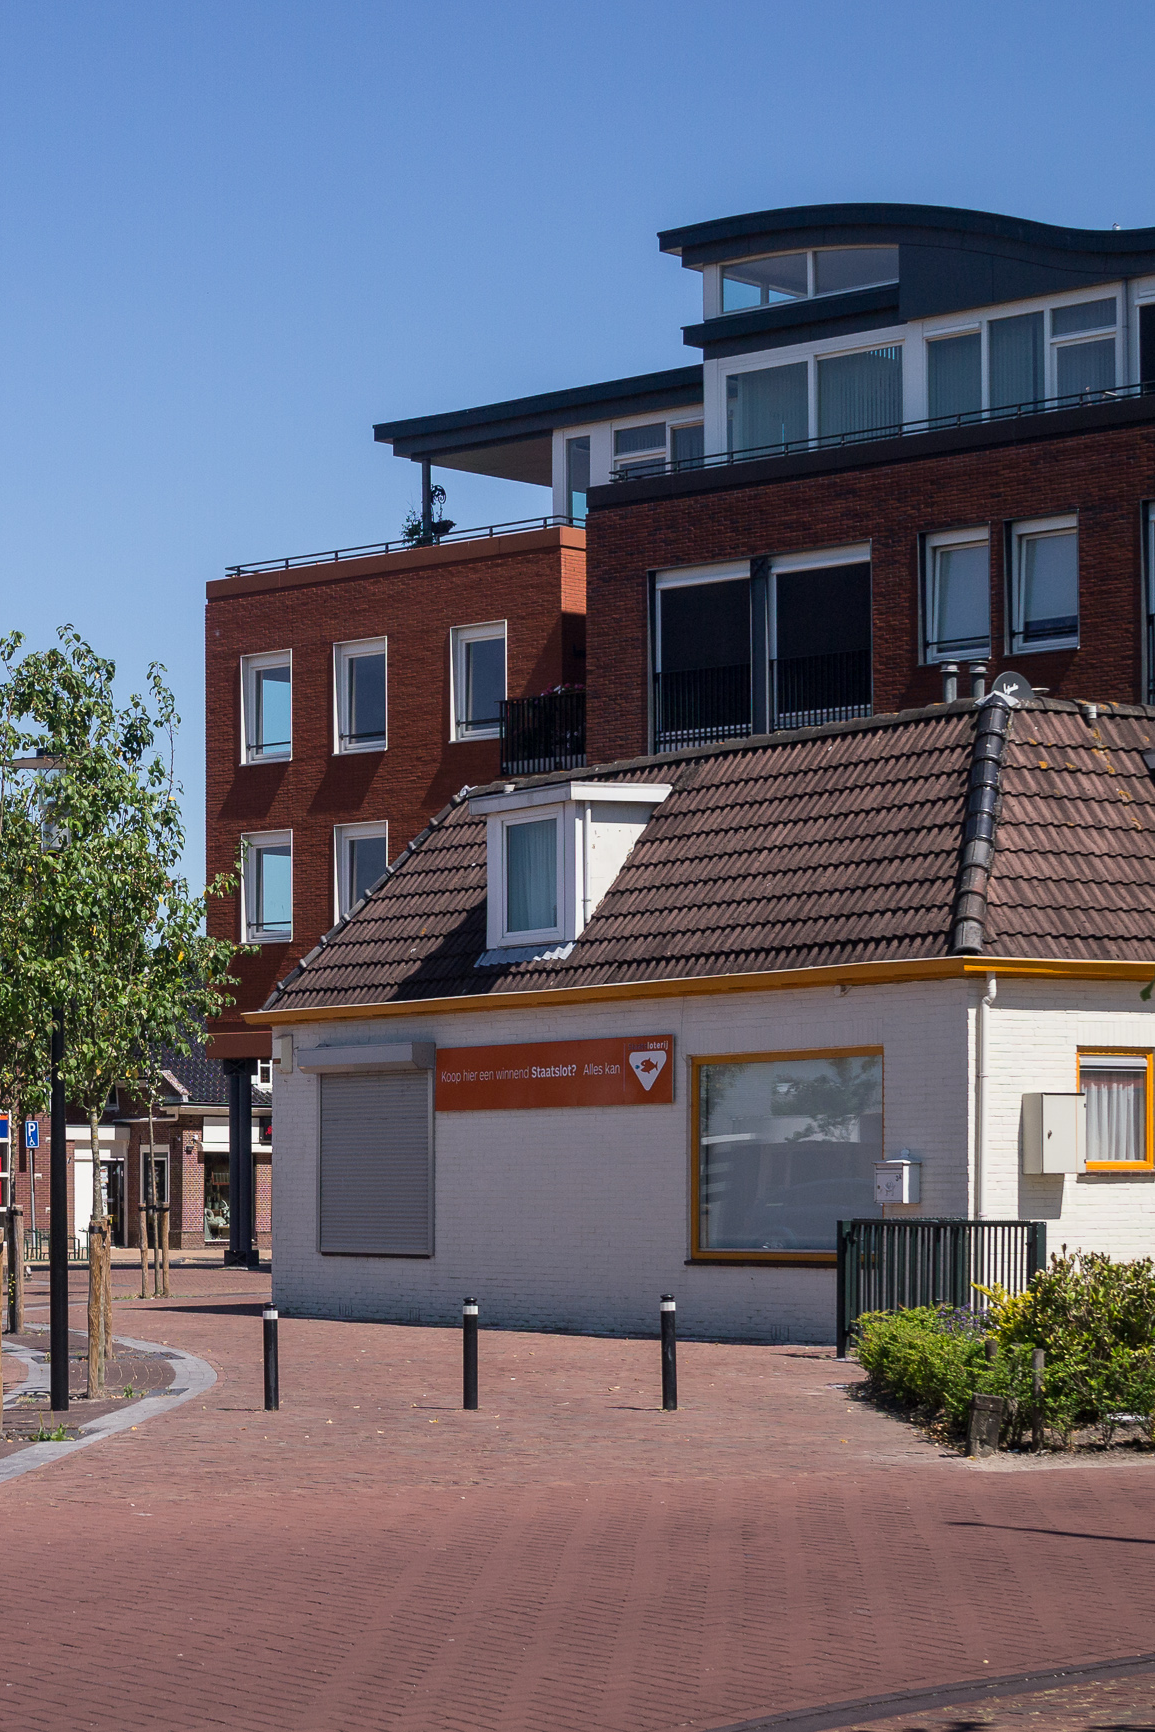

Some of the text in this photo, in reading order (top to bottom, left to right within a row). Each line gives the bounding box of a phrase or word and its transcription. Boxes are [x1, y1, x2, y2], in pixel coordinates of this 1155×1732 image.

[441, 1062, 621, 1084] Koop hier een winnend Staatslot? Alles kan
[28, 1122, 36, 1136] P
